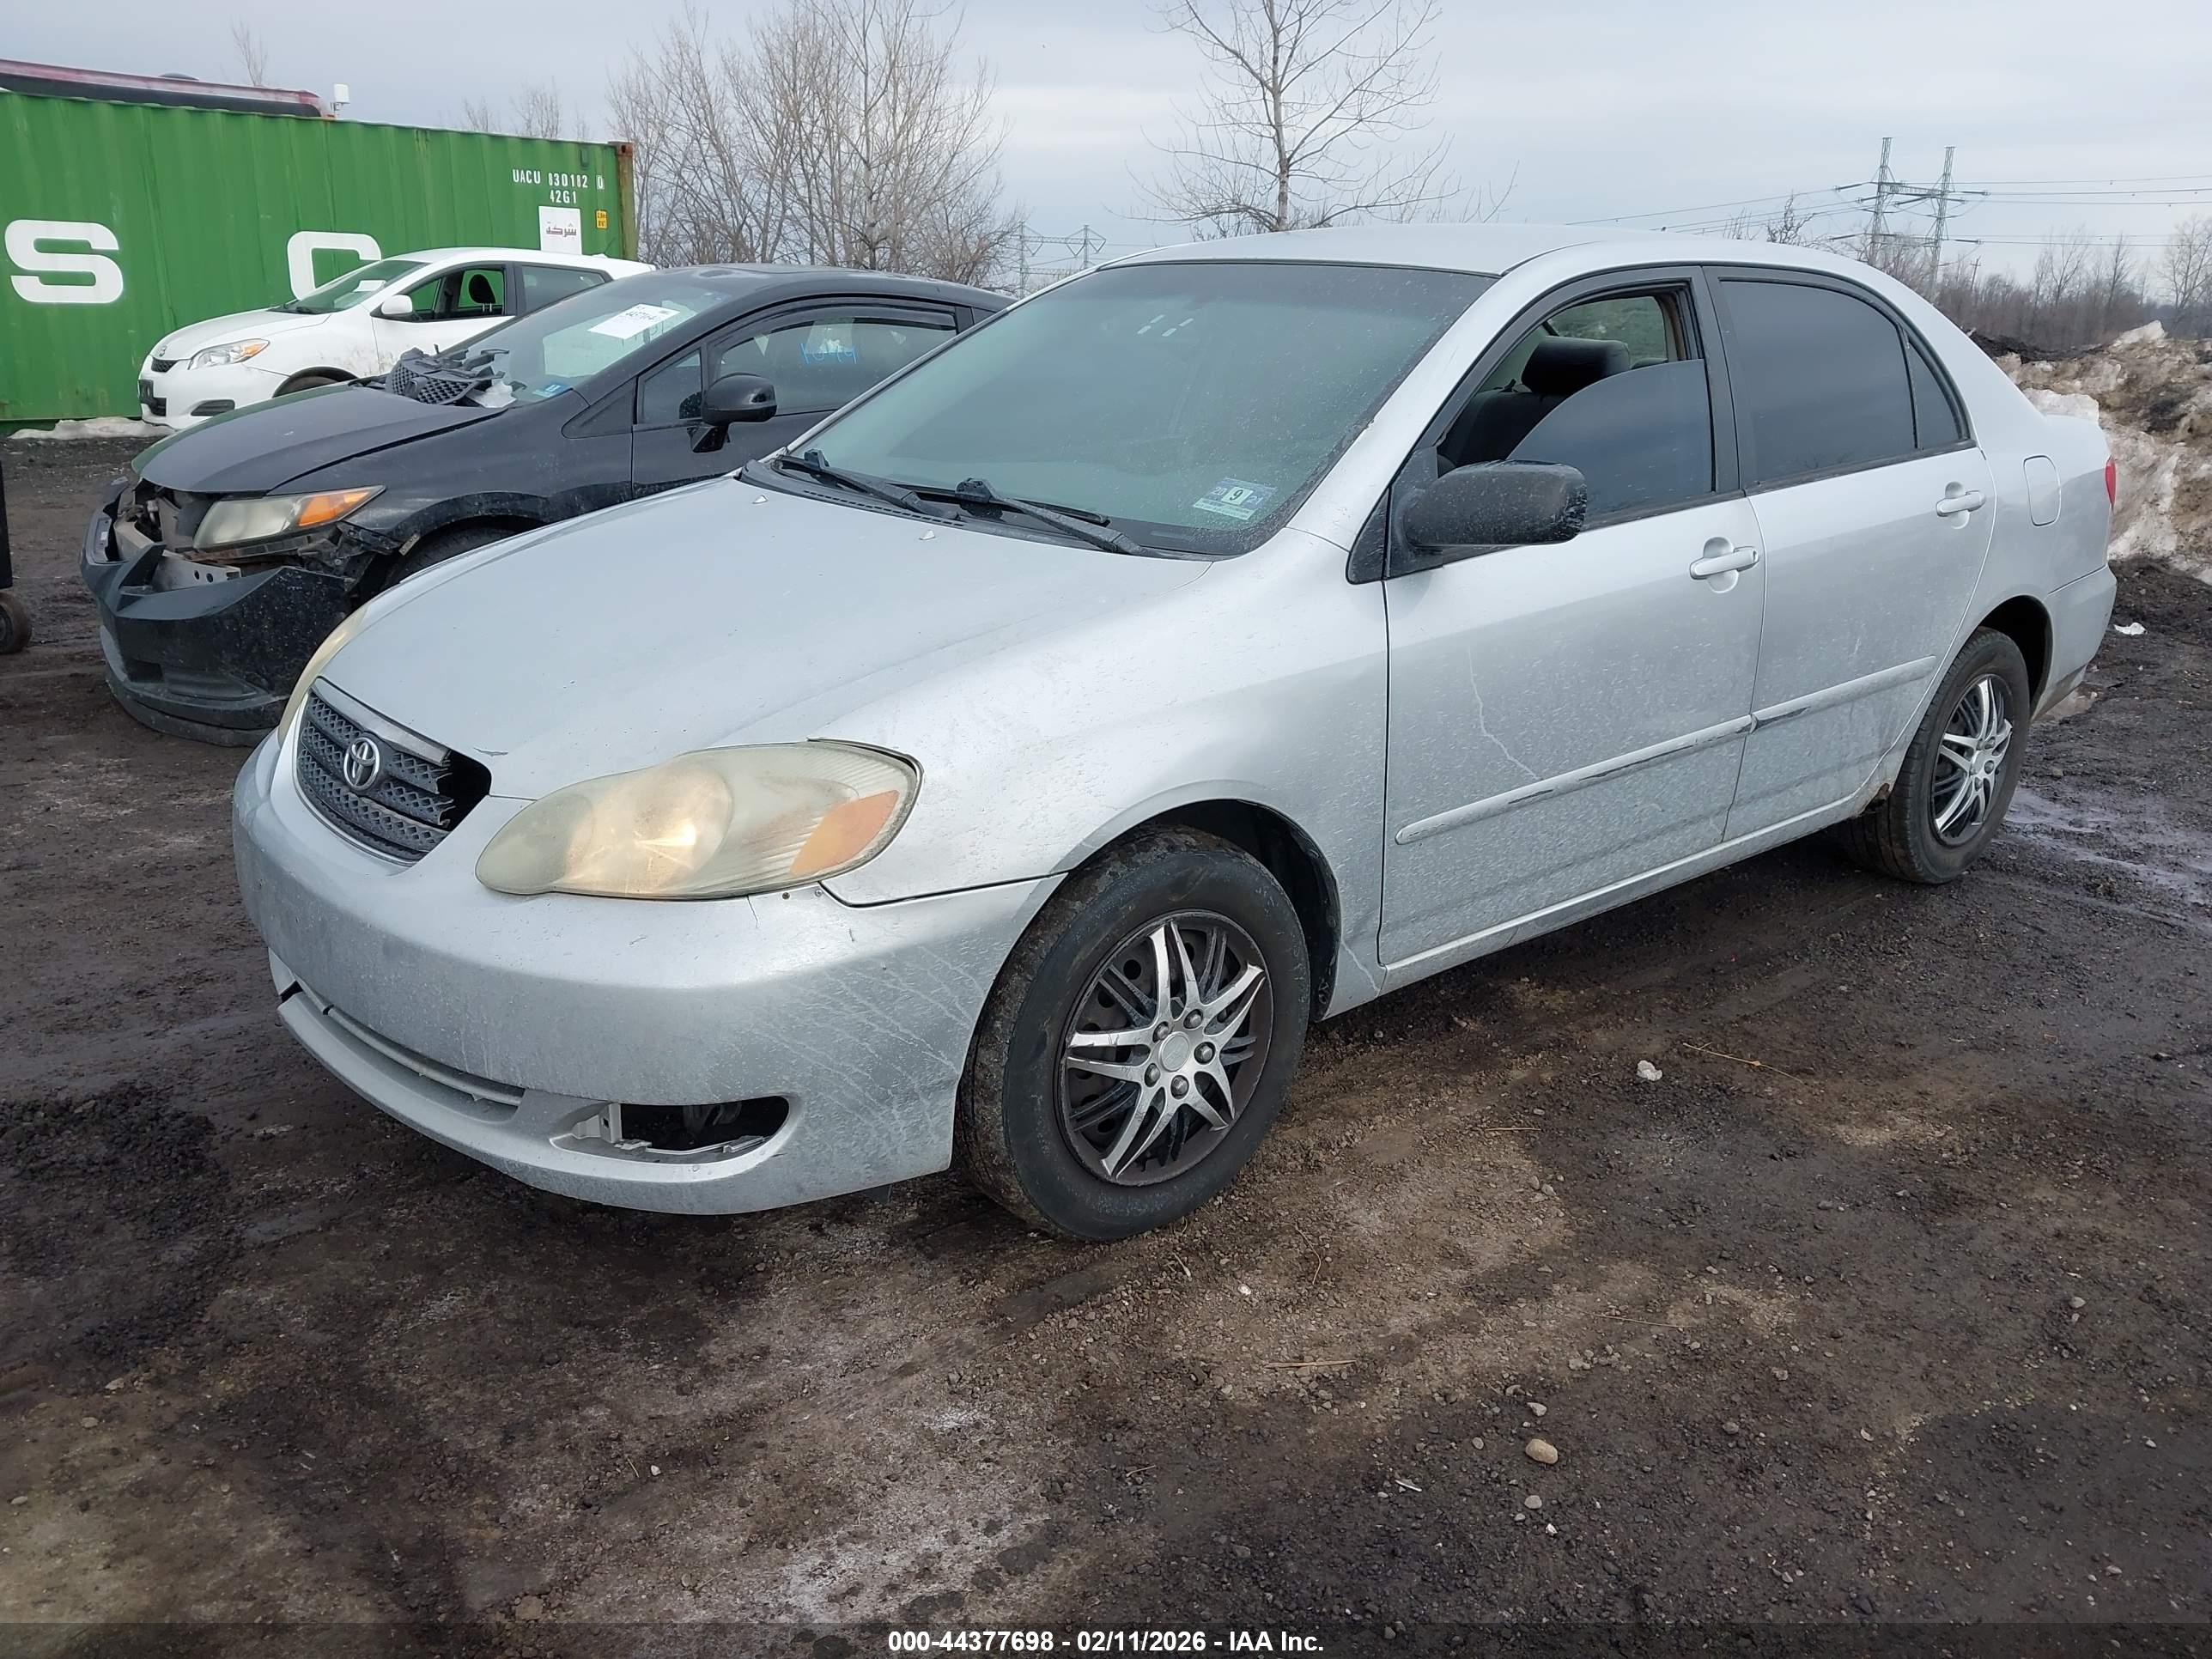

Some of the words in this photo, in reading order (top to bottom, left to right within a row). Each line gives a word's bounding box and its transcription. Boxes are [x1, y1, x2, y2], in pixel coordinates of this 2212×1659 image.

[512, 168, 541, 184] UACU
[550, 189, 577, 204] 42G1
[1229, 489, 1244, 501] 9
